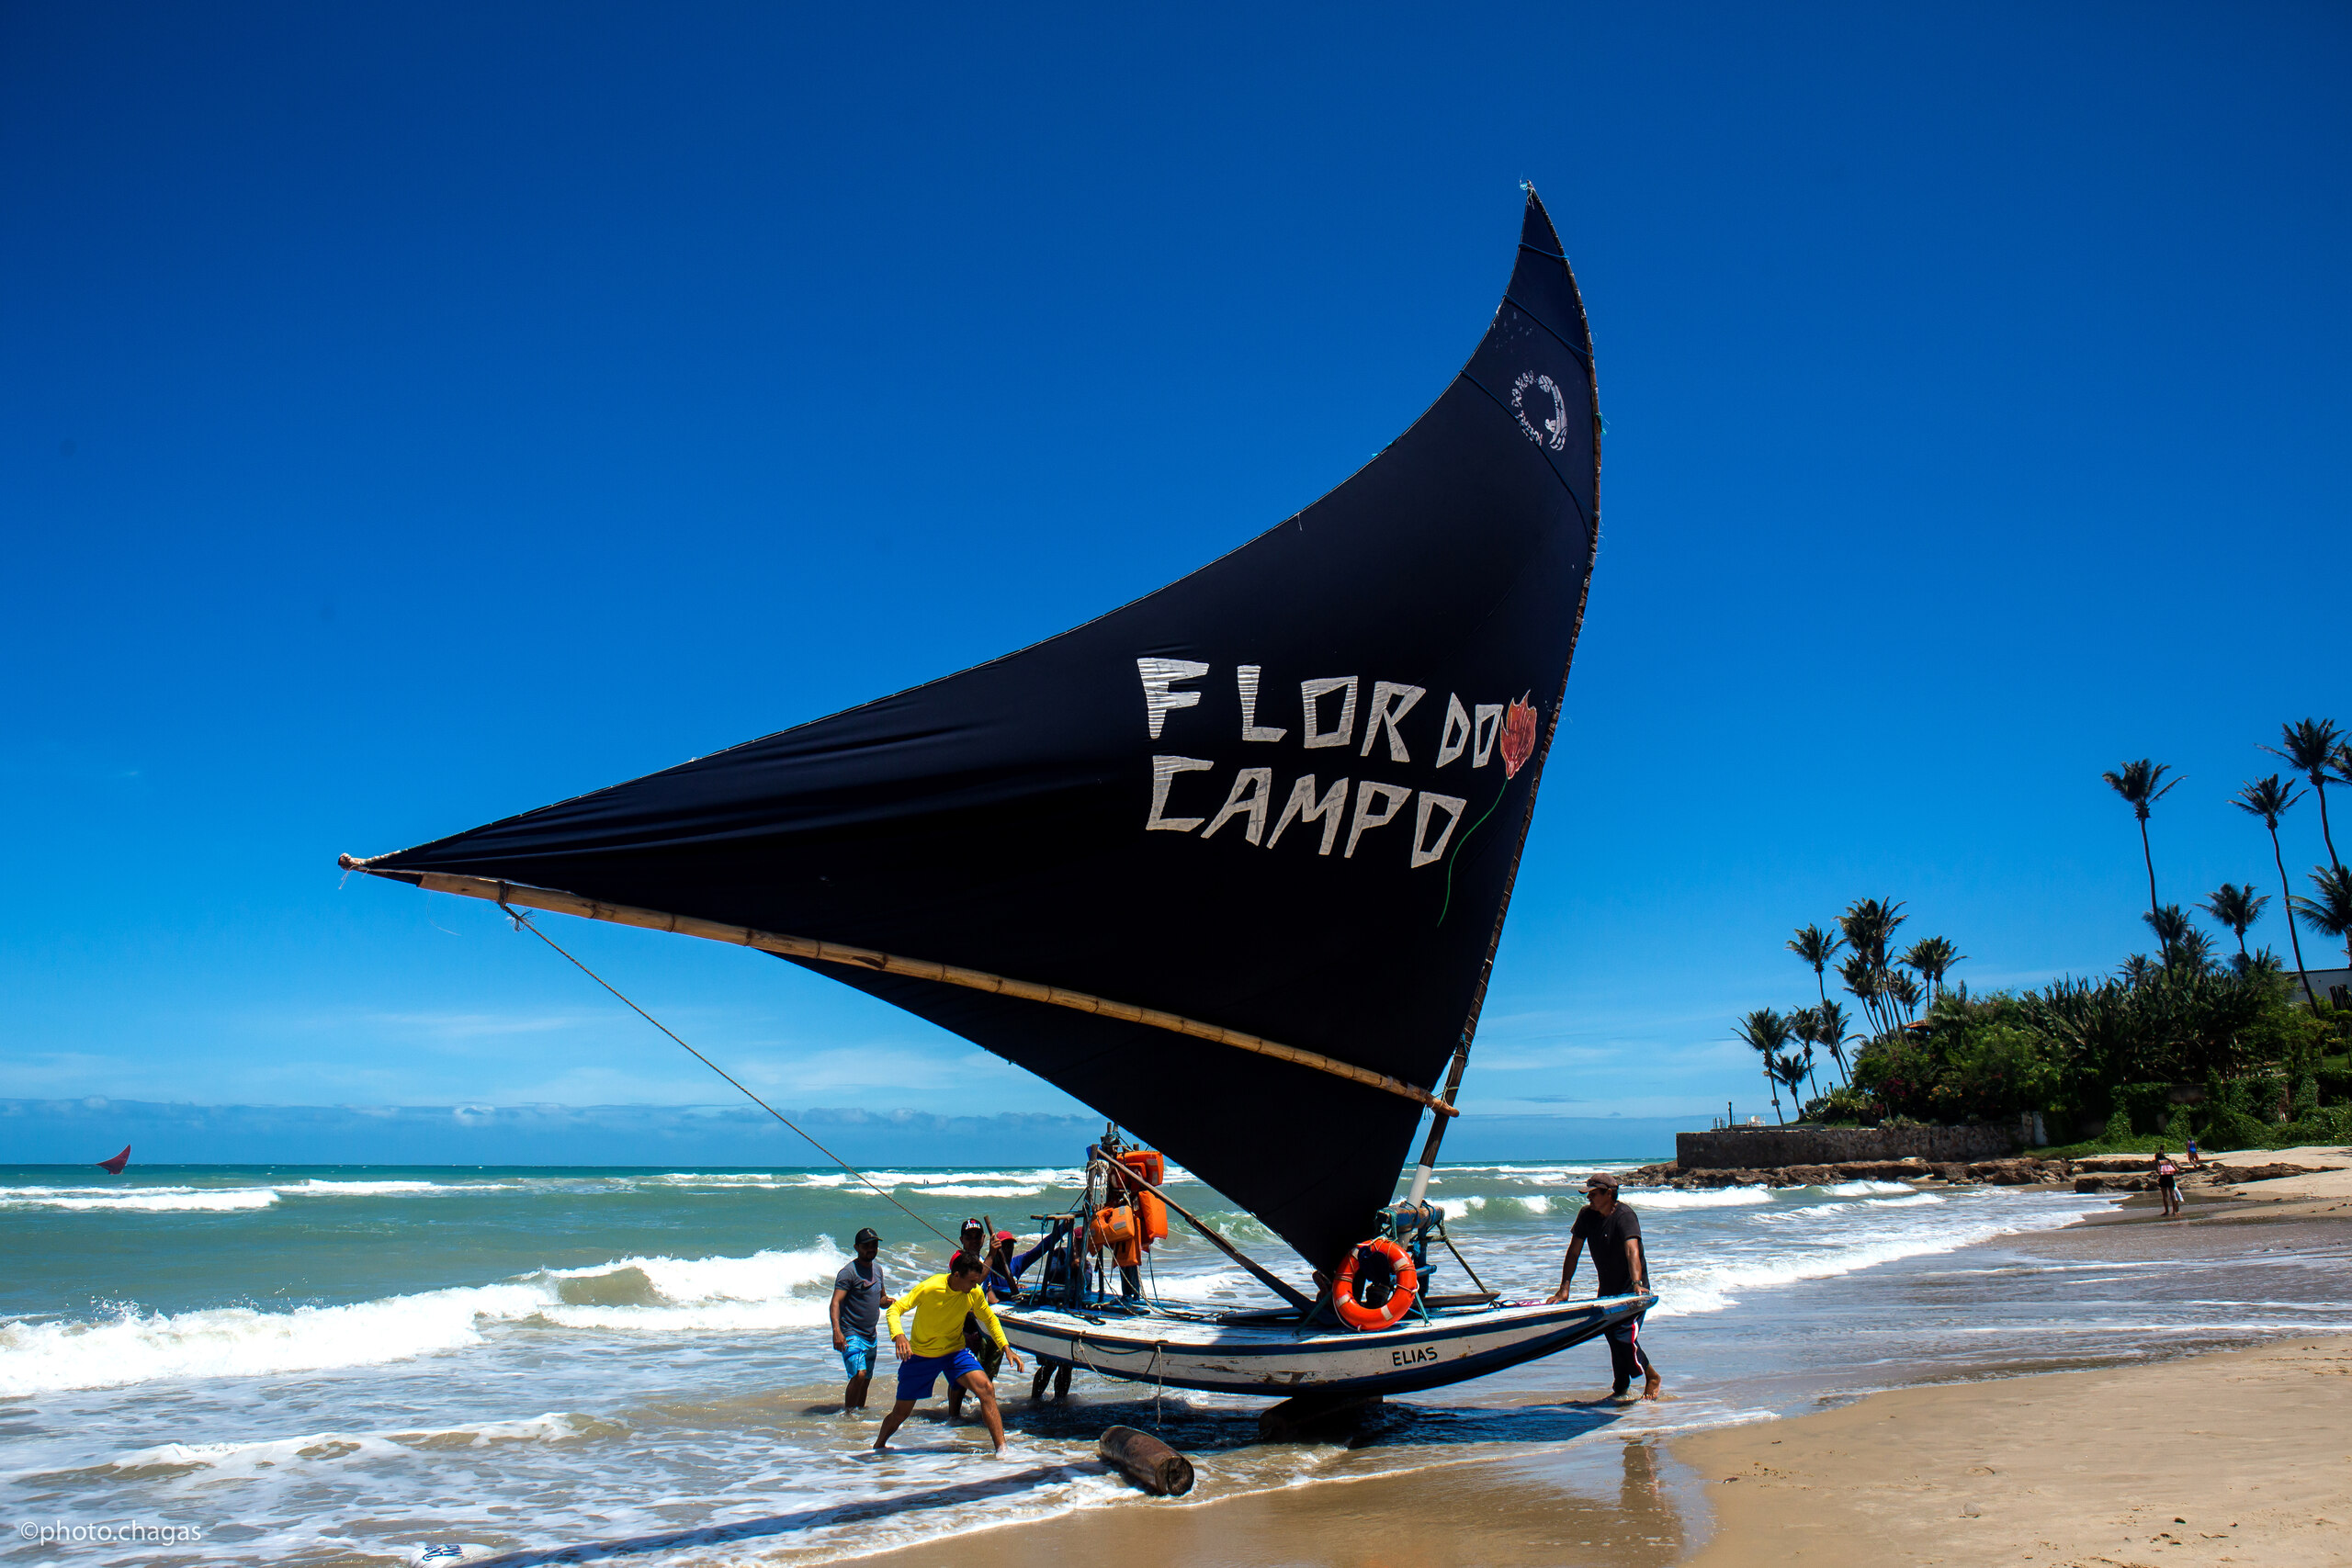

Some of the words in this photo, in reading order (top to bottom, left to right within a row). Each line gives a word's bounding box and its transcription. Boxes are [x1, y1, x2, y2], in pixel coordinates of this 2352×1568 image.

[1136, 657, 1427, 763] FLOR
[1435, 692, 1505, 769] DO
[1145, 754, 1467, 869] CAMPO
[1391, 1346, 1439, 1367] ELIAS
